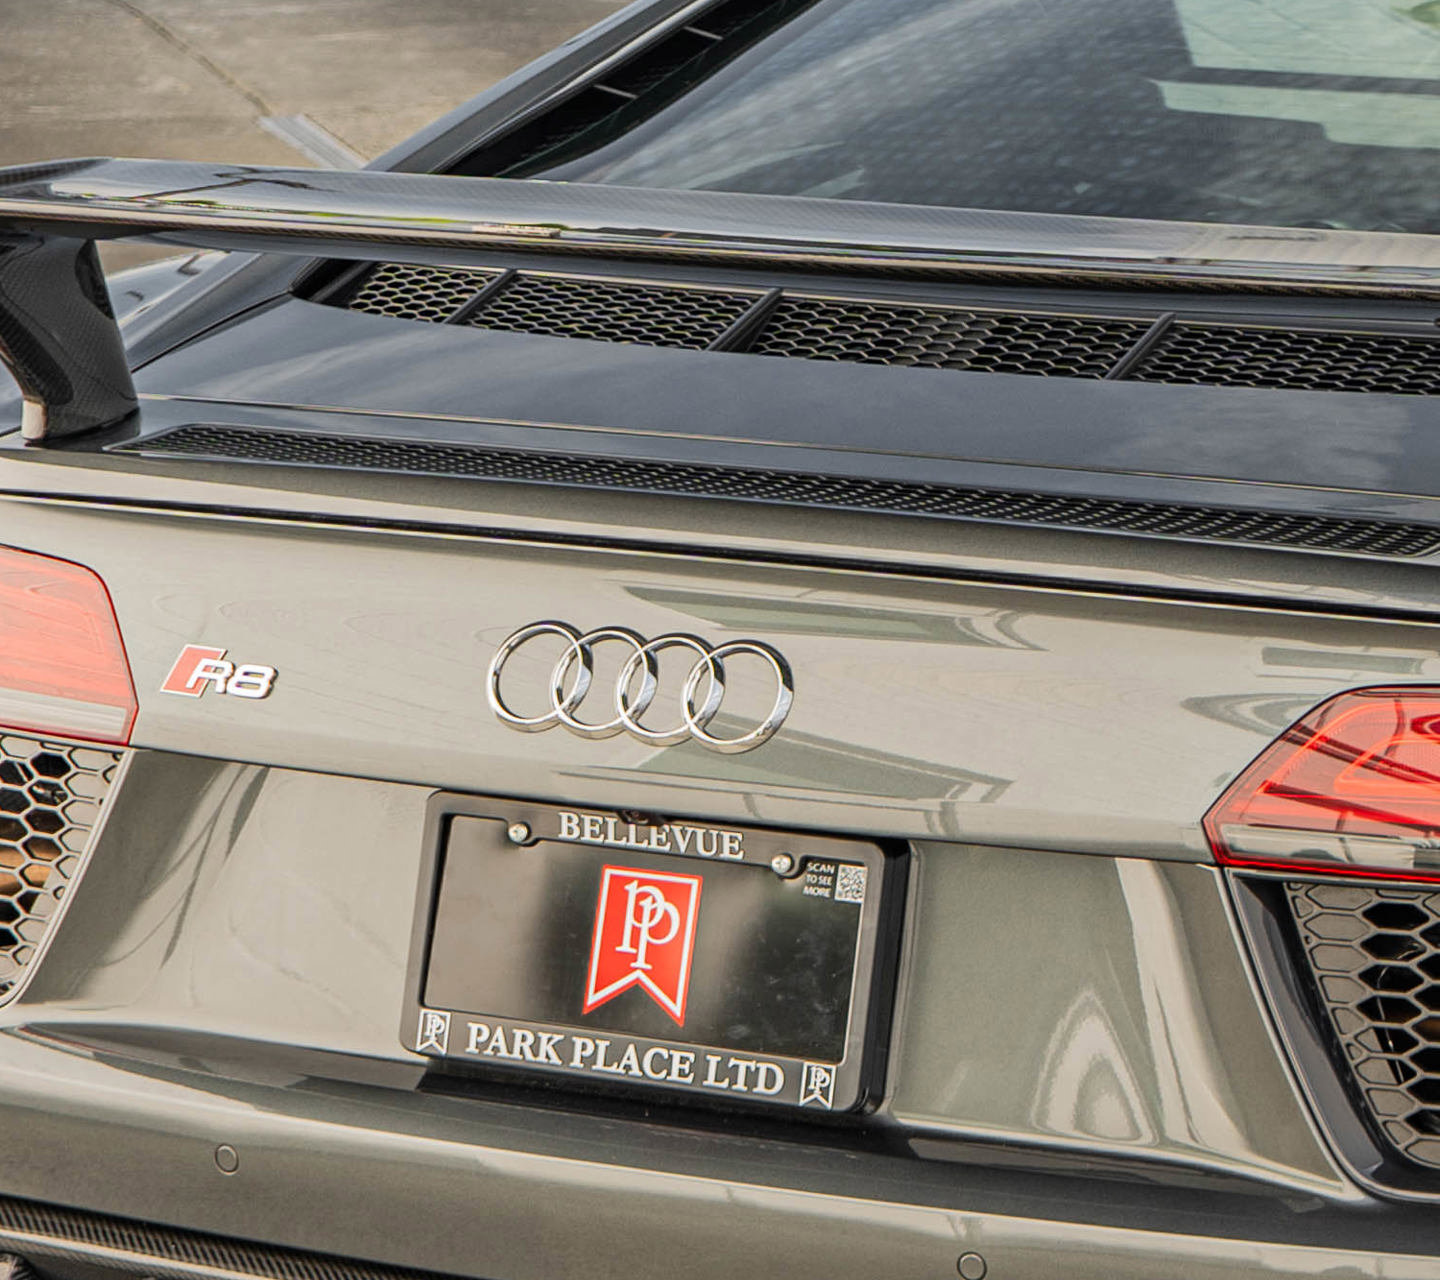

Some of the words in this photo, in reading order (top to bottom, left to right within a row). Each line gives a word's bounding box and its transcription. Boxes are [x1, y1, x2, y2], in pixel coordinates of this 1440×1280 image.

[184, 657, 280, 700] R8
[558, 811, 745, 860] BELLEVUE
[805, 873, 818, 884] TO
[818, 875, 833, 886] SEE
[806, 861, 836, 875] SCAN
[802, 885, 832, 898] MORE
[466, 1021, 565, 1067] PARK
[570, 1035, 696, 1084] PLACE
[703, 1055, 786, 1097] LTD
